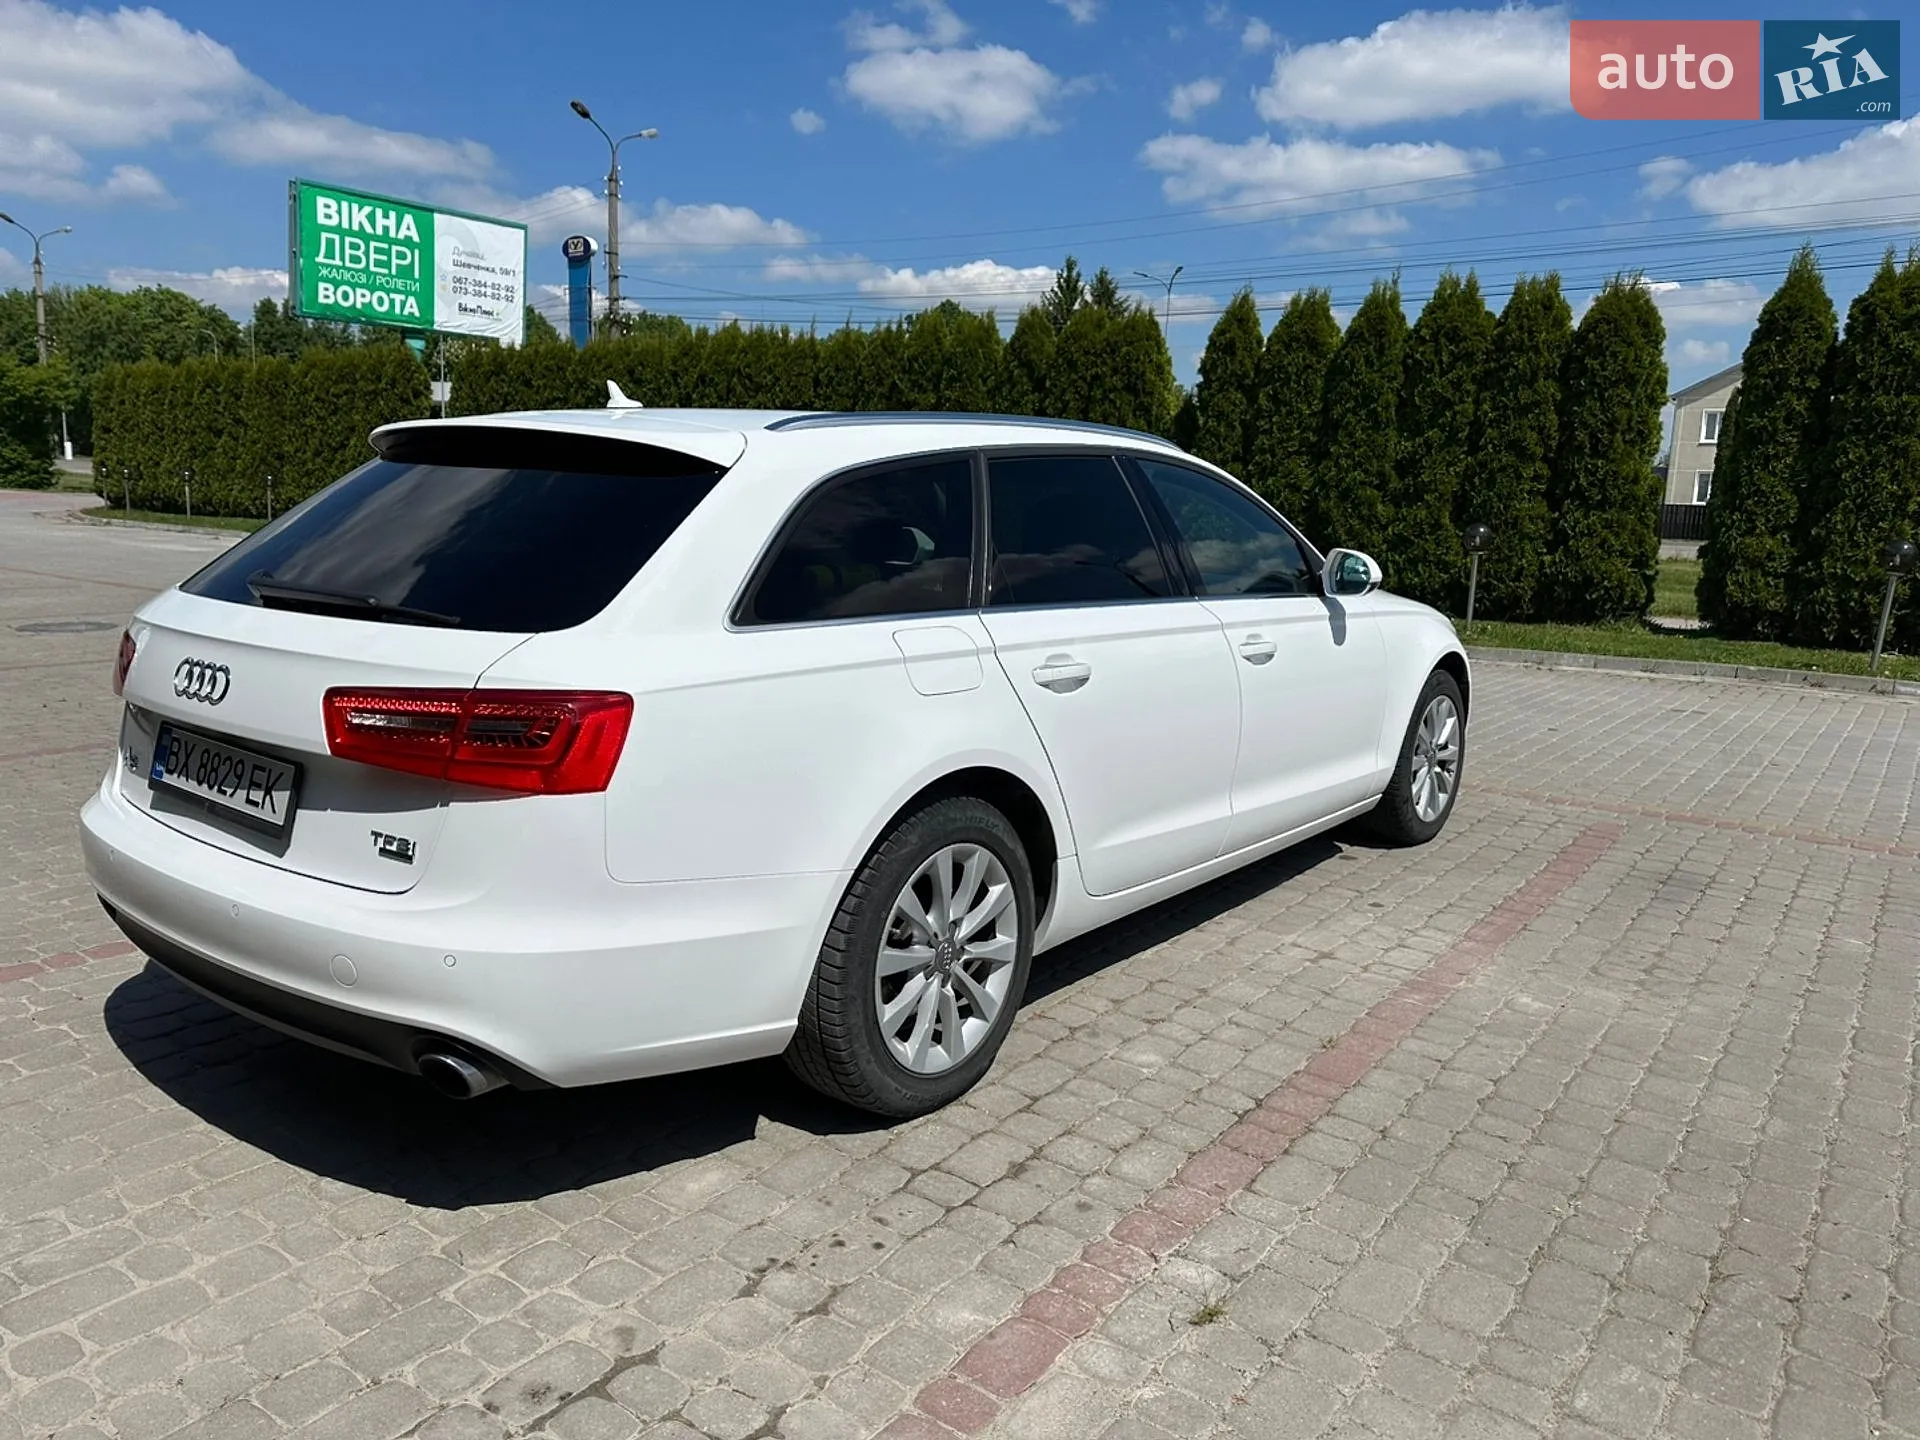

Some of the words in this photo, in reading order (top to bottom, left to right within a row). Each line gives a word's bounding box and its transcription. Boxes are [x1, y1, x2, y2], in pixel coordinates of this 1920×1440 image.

[316, 195, 420, 243] ВІКНА
[315, 231, 420, 279] ДВЕРІ
[317, 281, 420, 317] ВОРОТА
[376, 275, 420, 292] РОЛЕТИ
[452, 275, 515, 294] 067-384-82-92
[452, 285, 515, 303] 073-384-82-92
[165, 737, 196, 783] BX
[197, 747, 245, 798] 8829
[245, 764, 284, 814] EK
